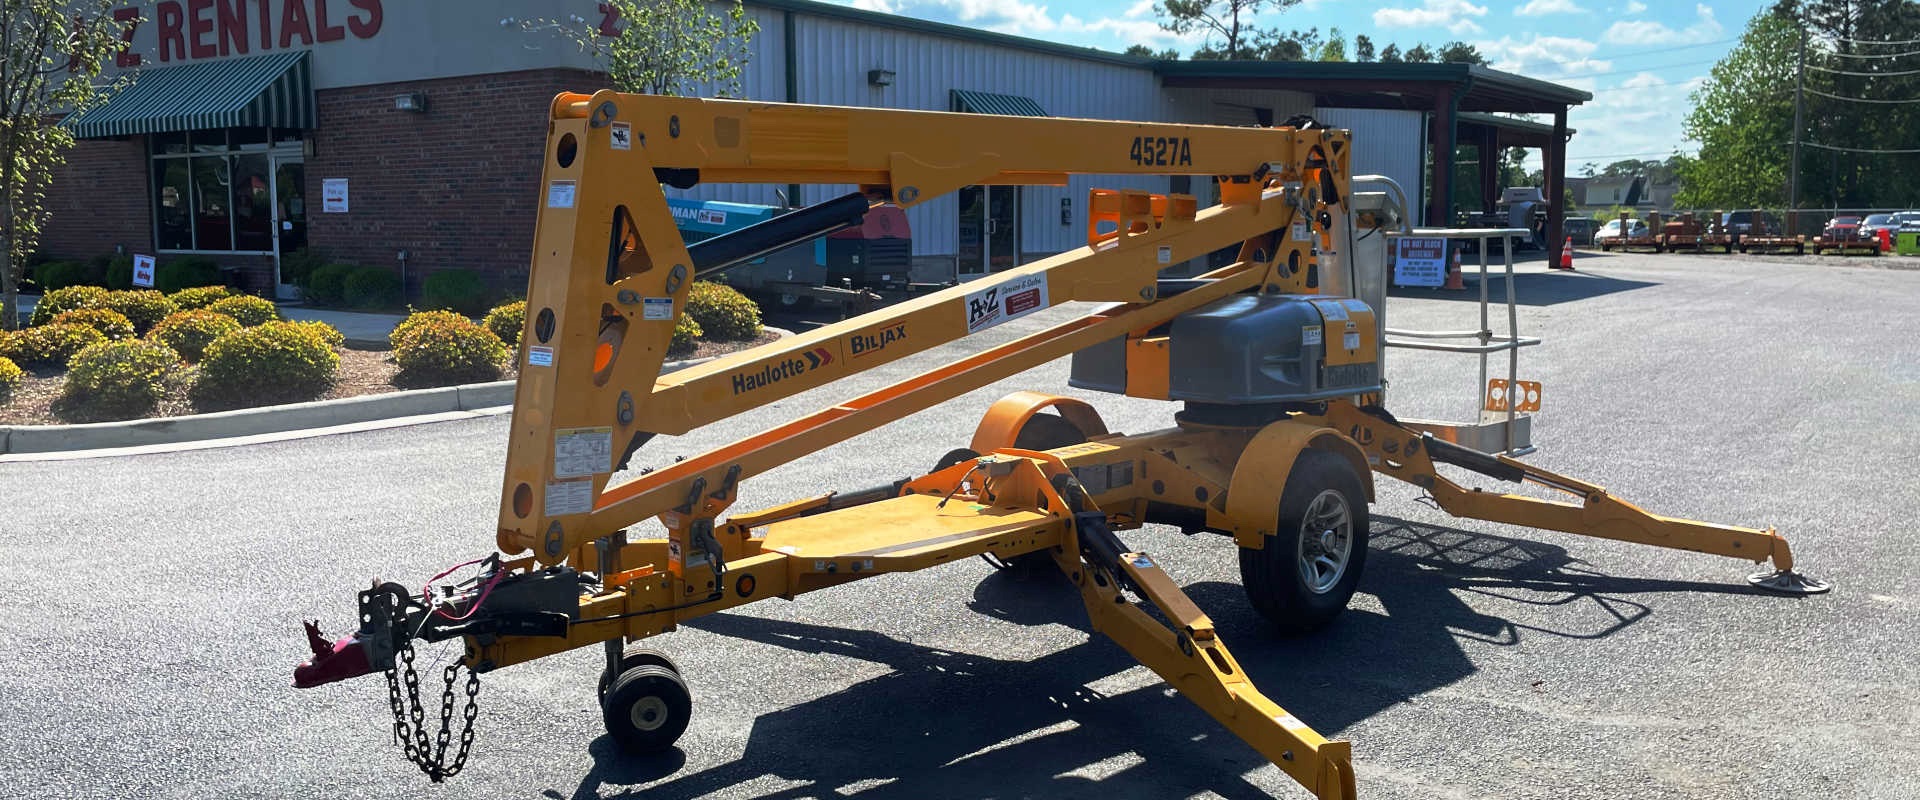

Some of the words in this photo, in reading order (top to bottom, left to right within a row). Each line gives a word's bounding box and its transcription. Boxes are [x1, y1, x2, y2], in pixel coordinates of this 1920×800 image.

[157, 0, 384, 62] RENTALS
[1130, 136, 1192, 166] 4527A
[732, 358, 805, 395] Haulotte
